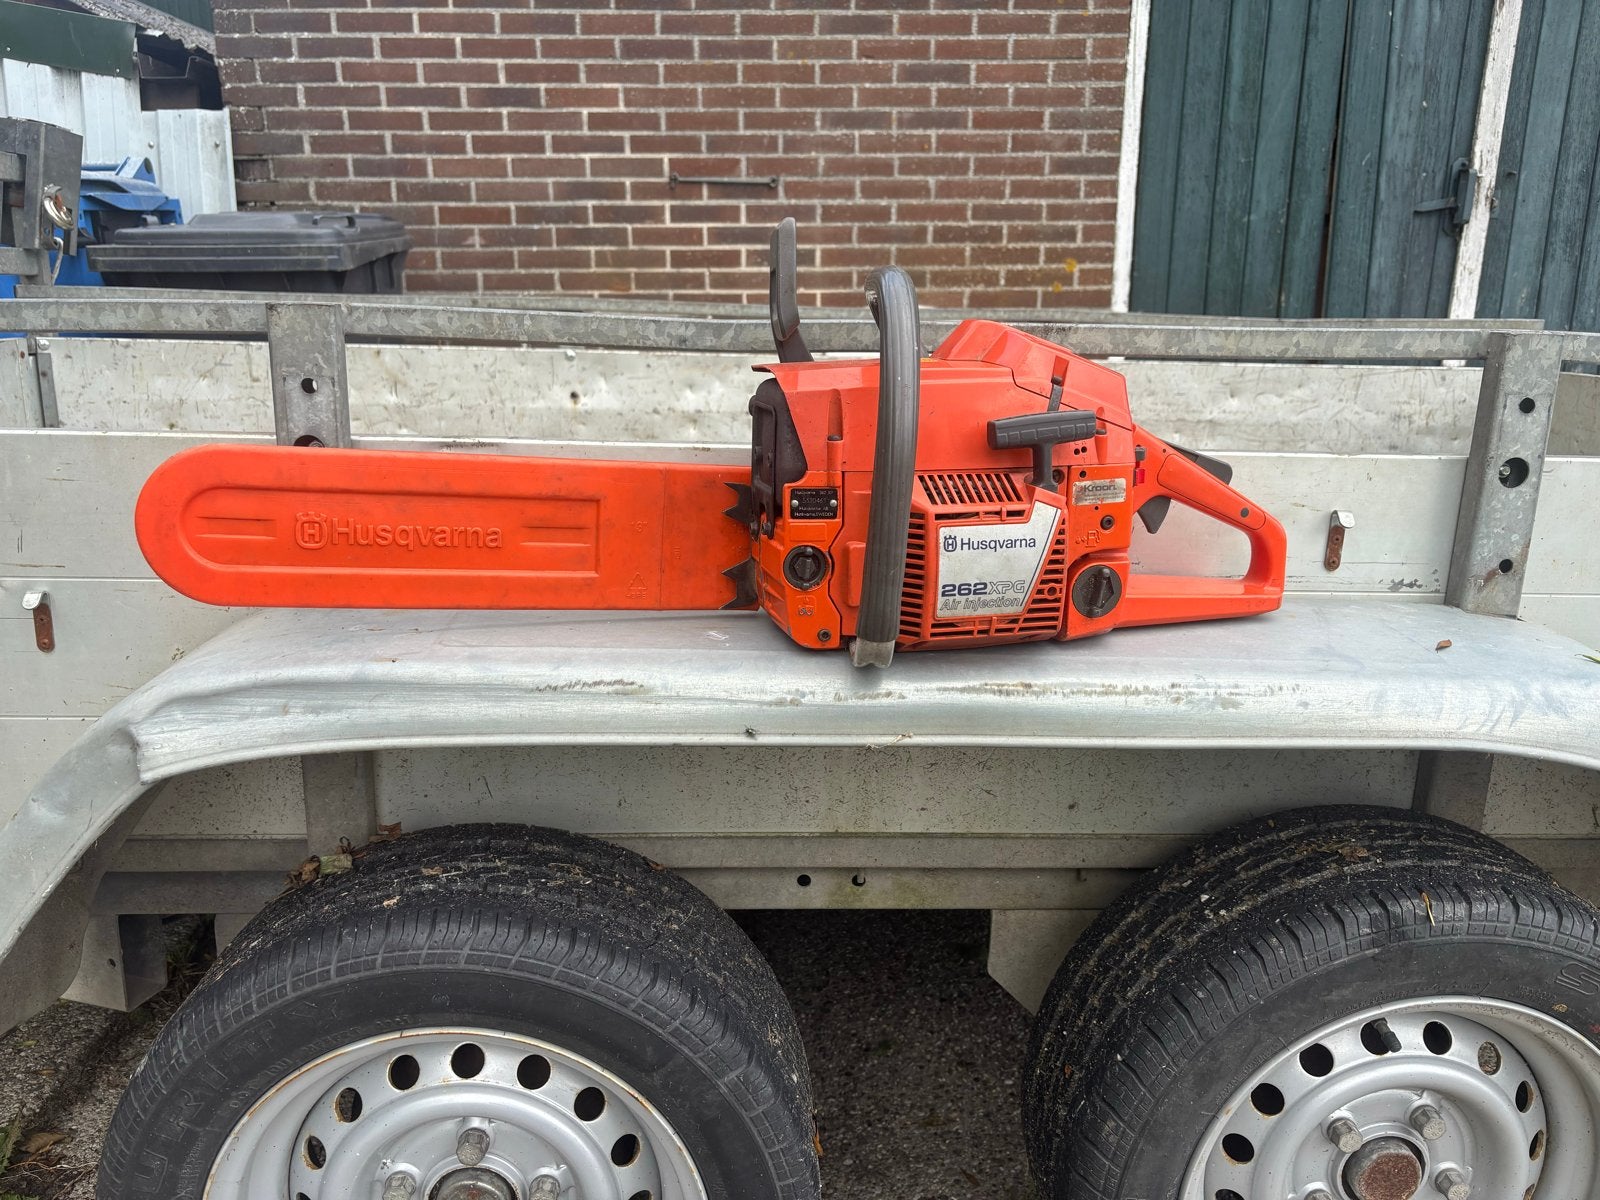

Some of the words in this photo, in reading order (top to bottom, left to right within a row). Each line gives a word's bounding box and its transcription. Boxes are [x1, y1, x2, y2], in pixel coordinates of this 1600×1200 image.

[332, 517, 503, 551] Husqvarna
[960, 537, 1036, 552] Husqvarna
[940, 598, 961, 611] Air
[963, 596, 1022, 612] injection
